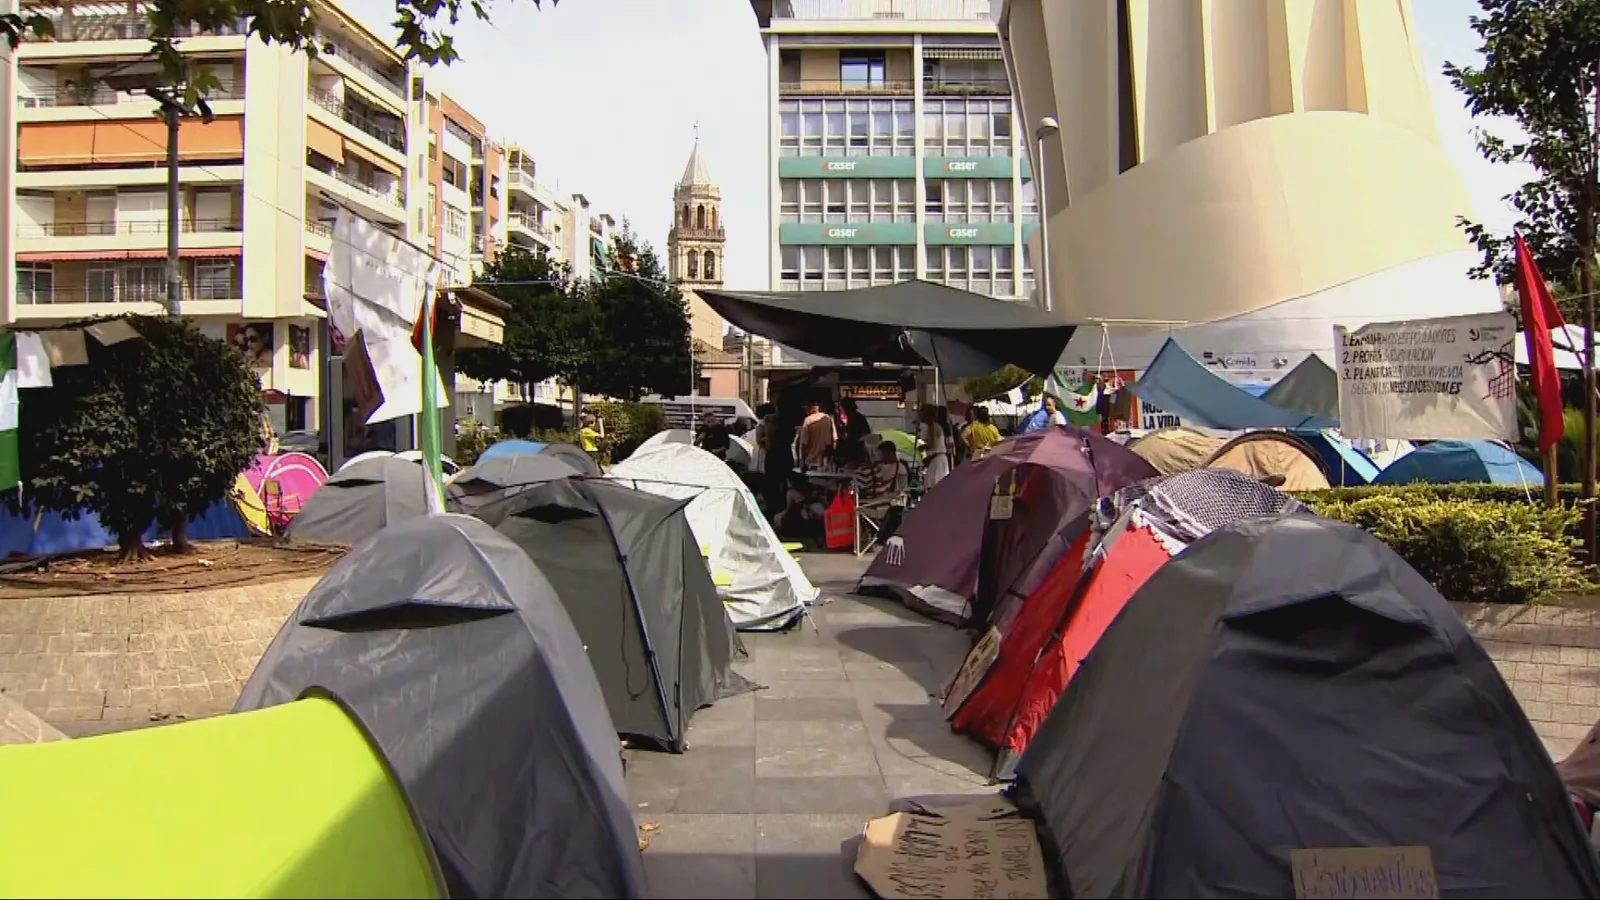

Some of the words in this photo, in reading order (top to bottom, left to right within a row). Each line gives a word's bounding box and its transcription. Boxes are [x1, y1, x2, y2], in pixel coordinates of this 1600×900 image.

[828, 160, 857, 171] caser
[948, 160, 978, 171] caser
[828, 227, 858, 238] caser
[949, 227, 979, 238] caser
[1428, 365, 1464, 379] VIVIENDA
[1143, 415, 1156, 430] LA
[1157, 413, 1181, 429] VIDA
